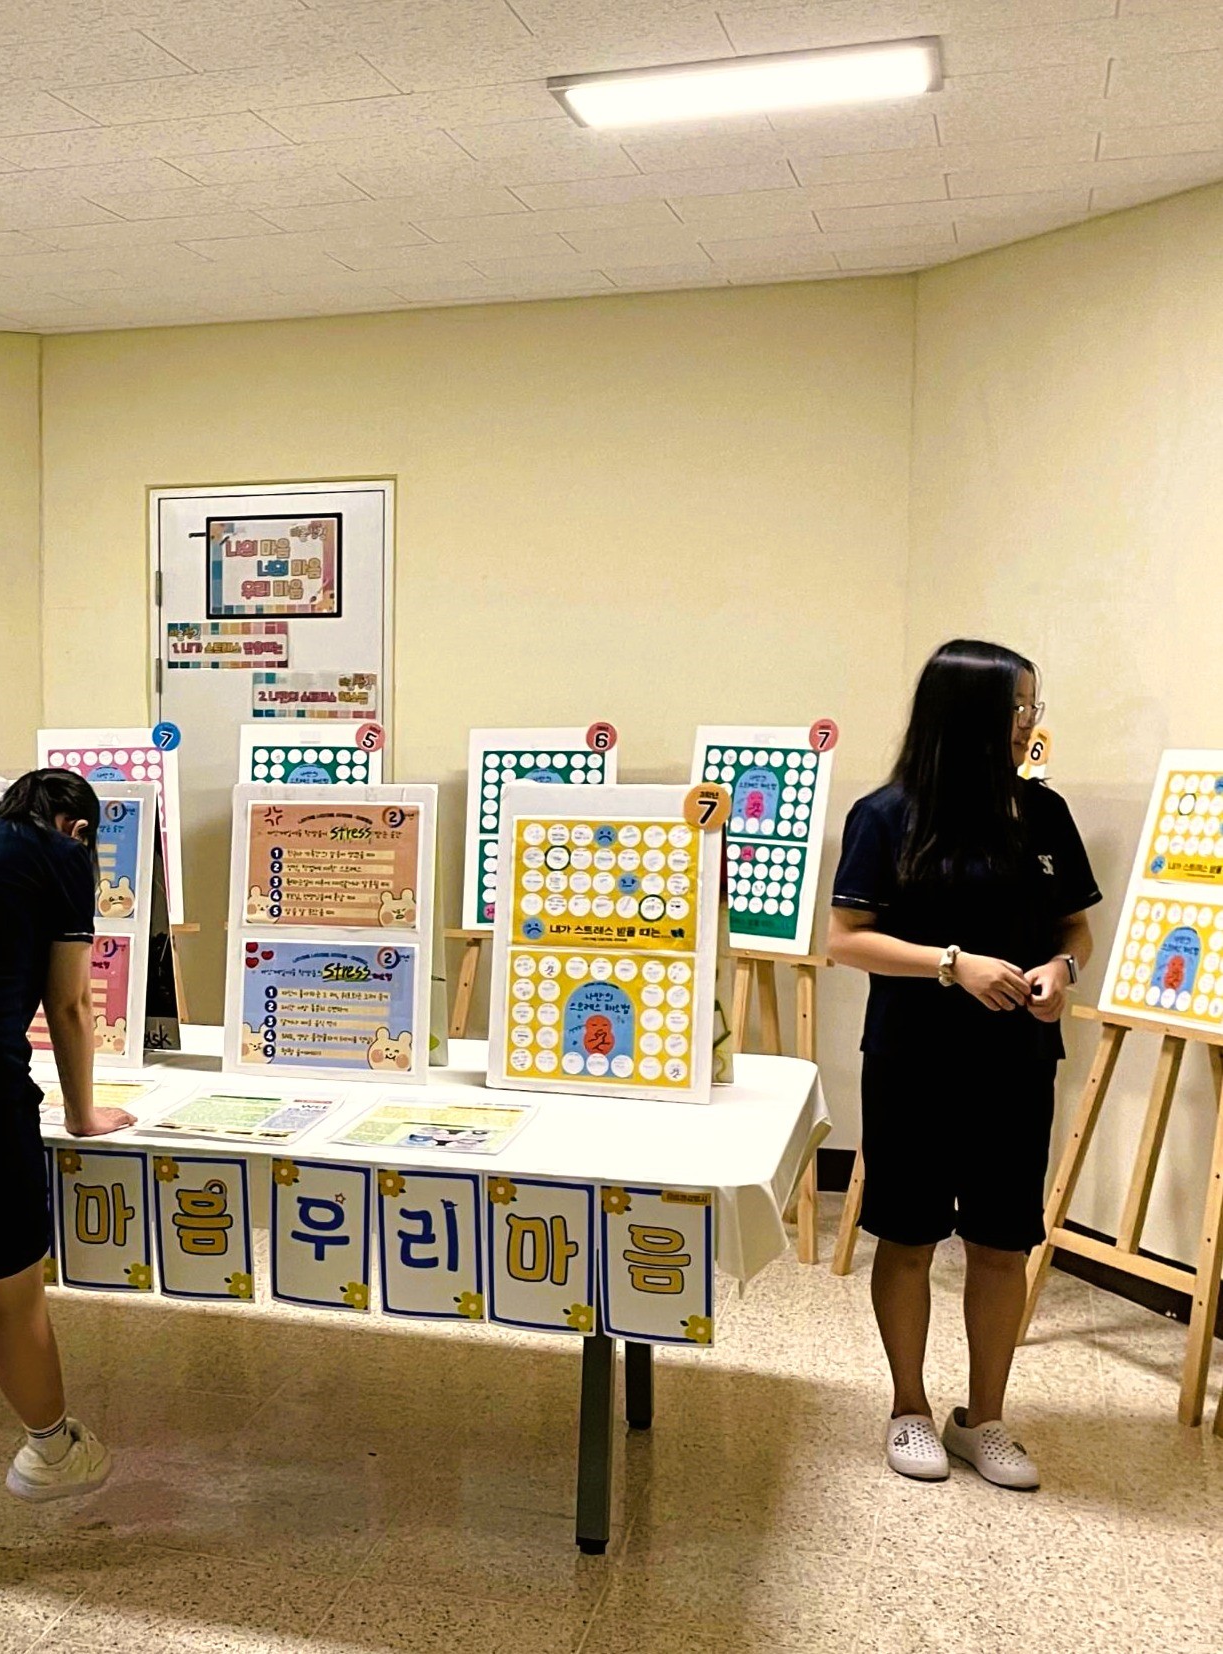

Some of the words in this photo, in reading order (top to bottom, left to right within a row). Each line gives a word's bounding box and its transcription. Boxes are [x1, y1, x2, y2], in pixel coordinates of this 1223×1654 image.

[225, 540, 258, 557] 나의
[260, 538, 291, 558] 마음
[257, 560, 289, 577] 너의
[291, 557, 322, 579] 마음
[241, 581, 271, 600] 우리
[273, 579, 304, 600] 마음
[161, 732, 173, 748] 7
[362, 732, 378, 749] 5
[595, 732, 609, 749] 6
[819, 731, 831, 748] 7
[1030, 742, 1044, 761] 6
[388, 811, 398, 823] 2
[698, 800, 718, 824] 7
[550, 925, 571, 934] 내가
[574, 925, 614, 936] 스트레스
[384, 952, 392, 964] 2
[585, 992, 614, 1002] 나만의
[569, 1002, 602, 1012] 스트레스
[74, 1181, 234, 1256] 마음
[290, 1195, 460, 1272] 우리
[505, 1212, 692, 1295] 마음
